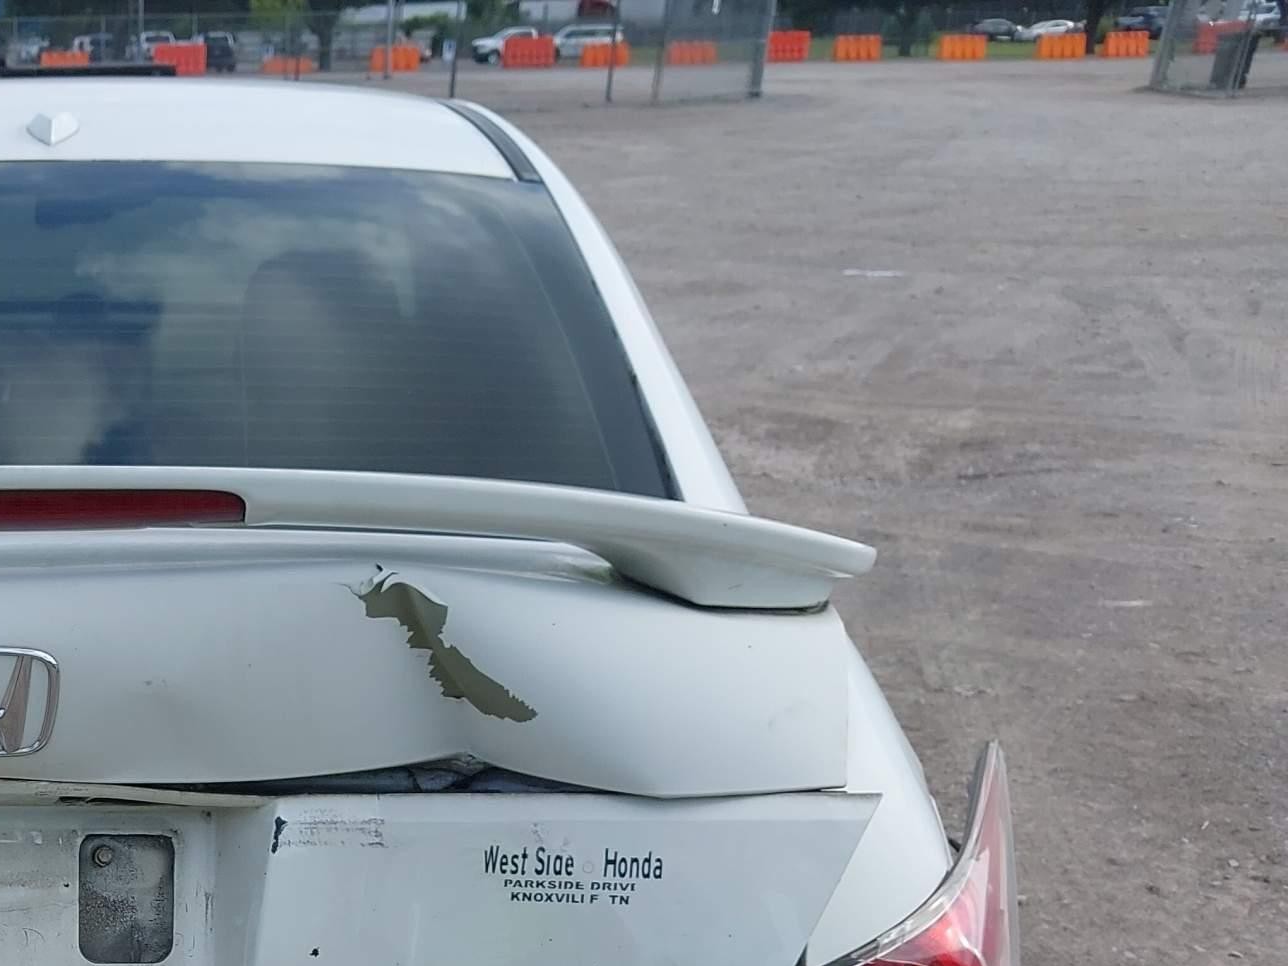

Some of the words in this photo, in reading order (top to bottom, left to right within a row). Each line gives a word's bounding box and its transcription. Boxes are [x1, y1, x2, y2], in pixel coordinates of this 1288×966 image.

[484, 845, 529, 876] West
[534, 846, 575, 877] Side
[603, 847, 664, 880] Honda
[503, 878, 585, 891] PARKSIDE
[609, 894, 630, 906] TN
